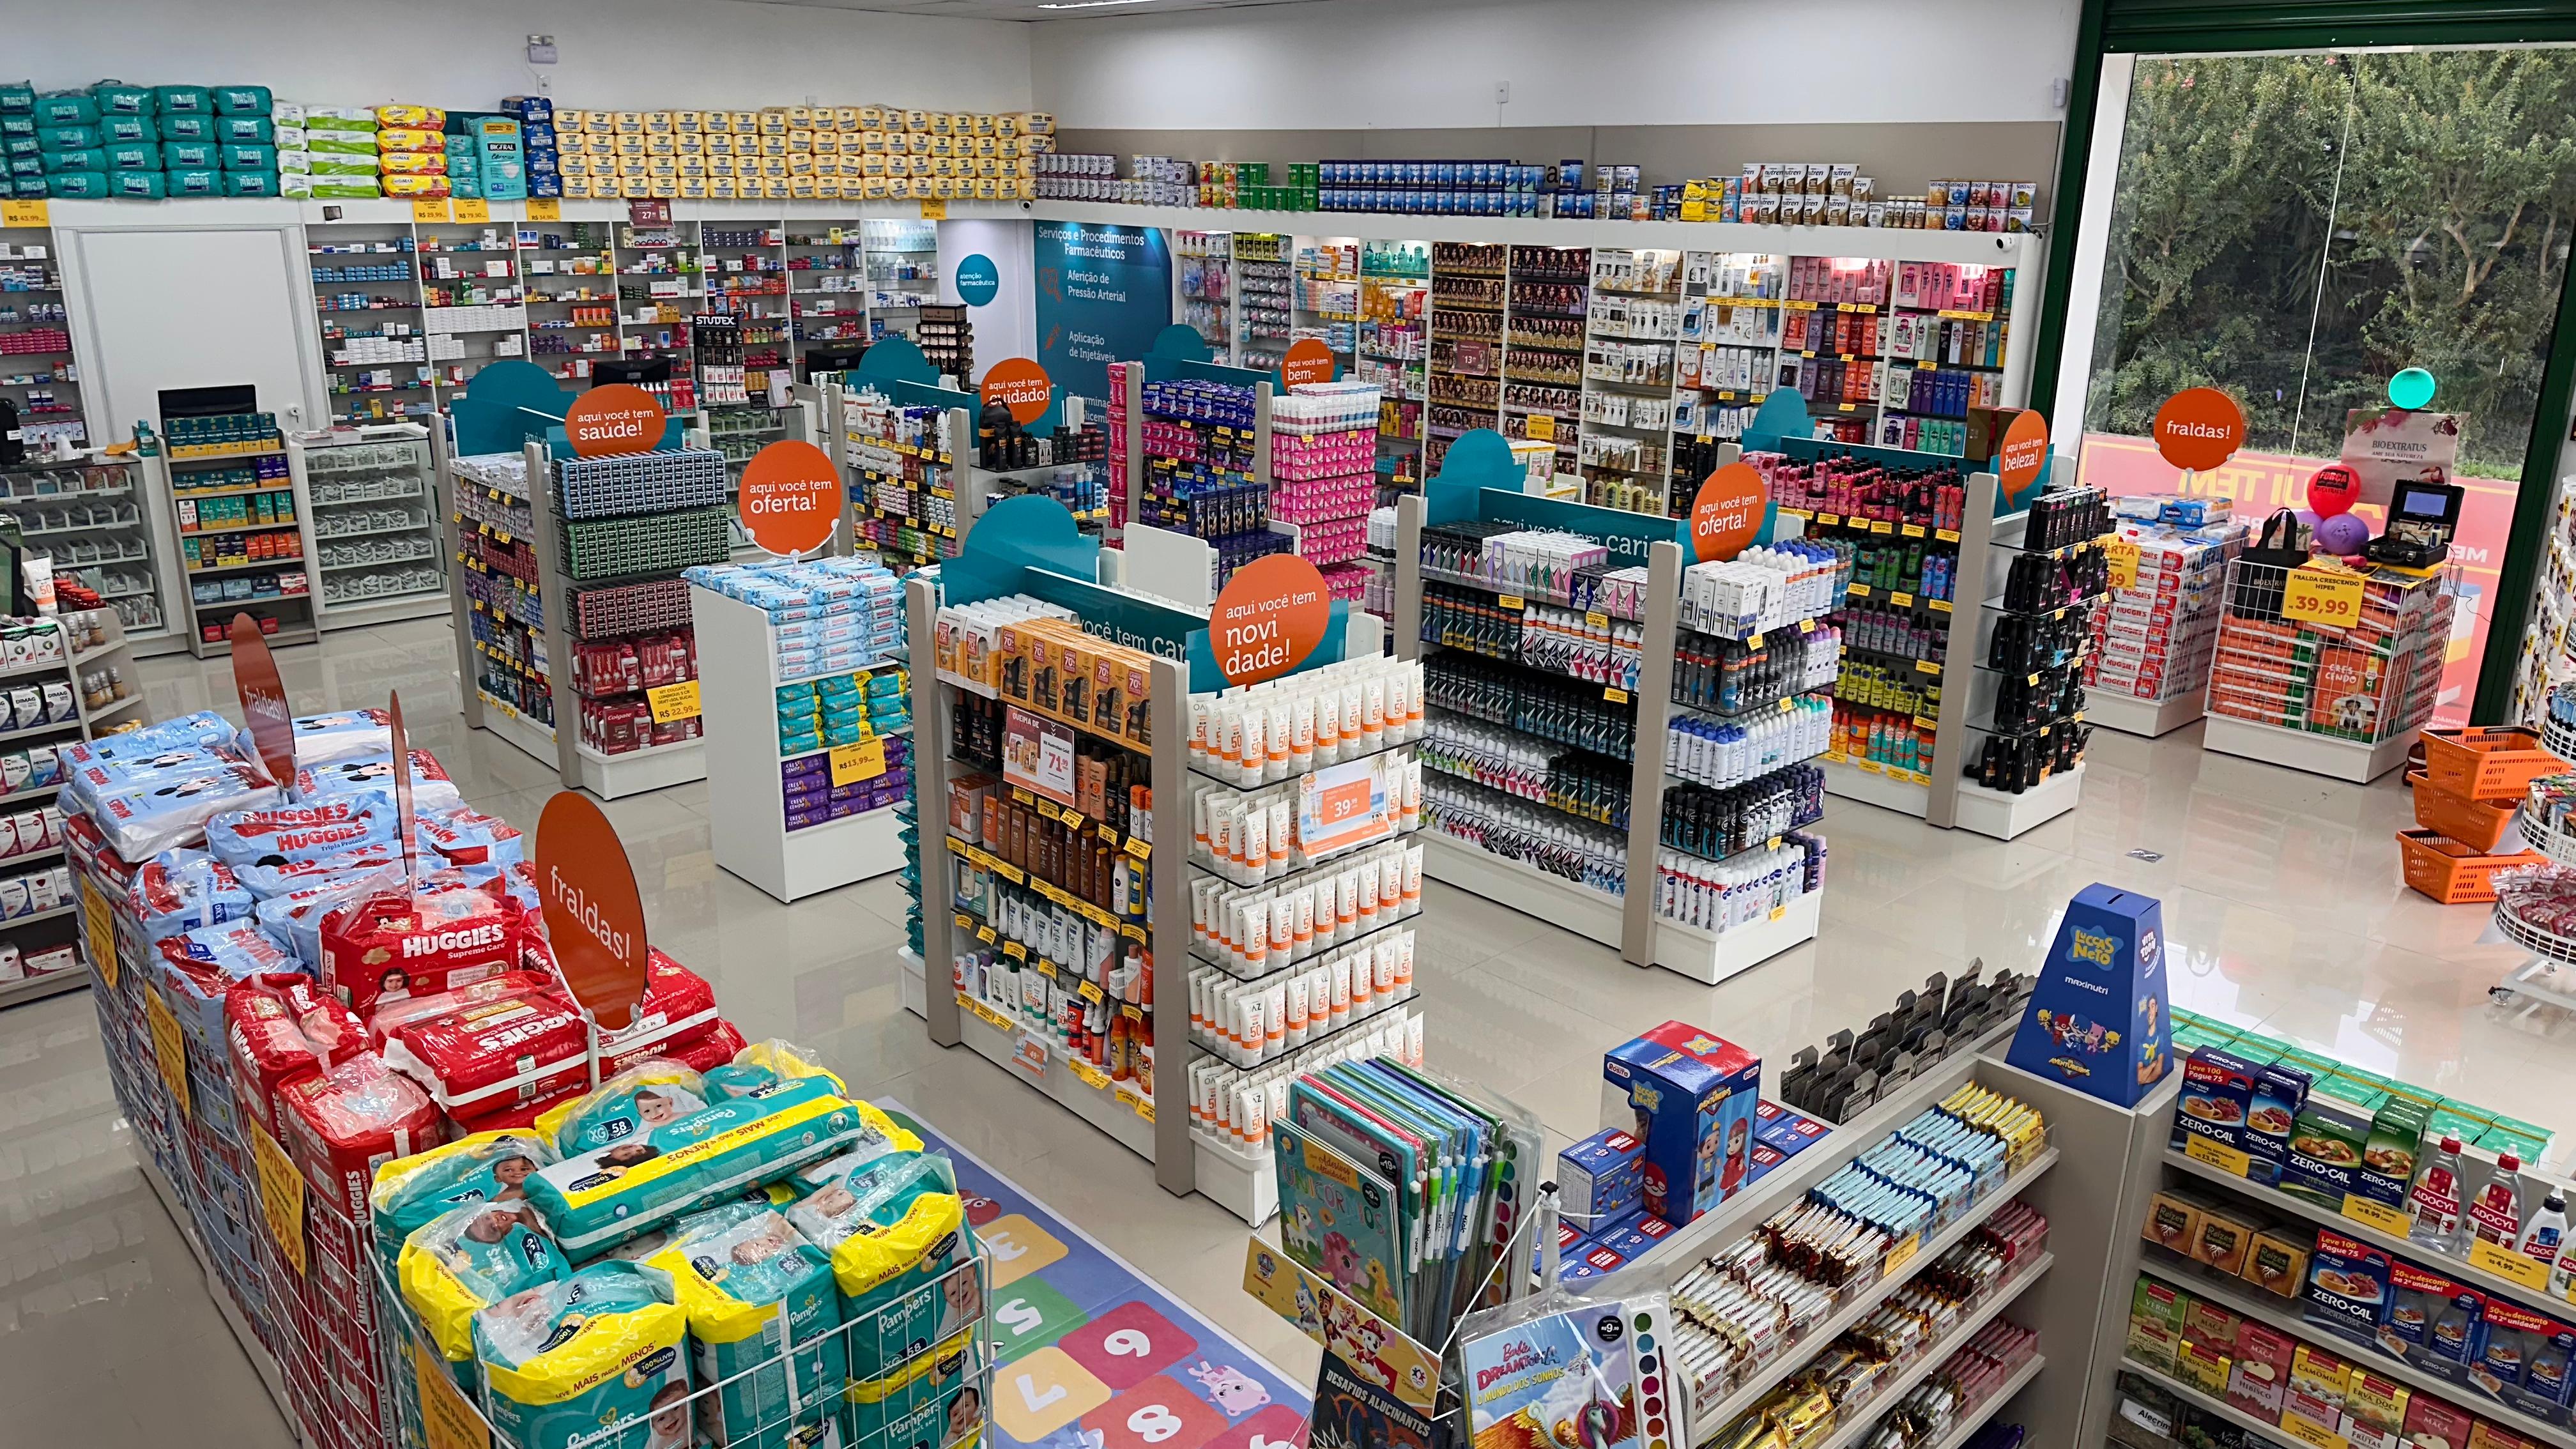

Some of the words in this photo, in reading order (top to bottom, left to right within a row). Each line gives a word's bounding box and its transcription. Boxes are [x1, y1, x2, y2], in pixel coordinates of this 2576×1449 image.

[1038, 226, 1071, 243] Serviços
[1080, 229, 1144, 245] Procedimentos
[1065, 244, 1124, 259] Farmacêuticos
[1068, 270, 1098, 285] Aferição
[1100, 273, 1109, 284] de
[1068, 286, 1096, 298] Pressão
[1098, 289, 1126, 302] Arterial
[696, 316, 735, 325] STUDEX
[1069, 331, 1104, 346] Aplicação
[1070, 347, 1078, 357] de
[1080, 348, 1115, 362] Injetáveis
[1288, 369, 1315, 381] bem-
[988, 381, 1006, 390] aqui
[1008, 379, 1025, 388] você
[990, 387, 1050, 405] cuidado!
[578, 412, 601, 424] aqui
[604, 410, 629, 420] você
[633, 410, 654, 418] tem
[579, 420, 642, 440] saúde!
[2166, 420, 2230, 439] fraldas!
[2006, 442, 2018, 454] aqui
[2019, 439, 2031, 450] você
[2005, 448, 2039, 471] beleza!
[749, 482, 776, 495] aqui
[779, 480, 806, 491] você
[810, 480, 832, 490] tem
[751, 492, 816, 514] oferta!
[1700, 503, 1719, 517] aqui
[1720, 496, 1740, 511] você
[1742, 494, 1757, 506] tem
[1698, 511, 1747, 537] oferta!
[2320, 577, 2359, 586] CRESCENDO
[1227, 602, 1255, 620] aqui
[1258, 594, 1288, 612] você
[1292, 591, 1316, 605] tem
[2296, 595, 2349, 615] 39,99
[1116, 626, 1147, 652] tem
[1226, 613, 1278, 648] novi
[1225, 639, 1290, 676] dade!
[245, 685, 284, 721] fraldas!
[671, 706, 693, 716] 22,99
[1032, 719, 1039, 728] DE
[848, 756, 868, 767] 13,99
[1130, 813, 1138, 825] 70
[276, 822, 367, 852] HUGGIES
[1390, 884, 1399, 896] 50
[551, 864, 630, 967] fraldas!
[1282, 925, 1291, 938] 50
[402, 924, 503, 958] HUGGIES
[1254, 935, 1264, 948] 50
[448, 947, 486, 959] Supreme
[486, 942, 506, 952] Care
[1402, 961, 1411, 973] 50
[2065, 976, 2108, 995] maxinutri
[1298, 1006, 1307, 1018] 50
[1250, 1025, 1261, 1038] 50
[2188, 1064, 2205, 1073] Leve
[2188, 1071, 2211, 1081] Pague
[590, 1126, 606, 1140] XG
[612, 1122, 626, 1133] 58
[1319, 1154, 1351, 1176] Adesivos
[346, 1169, 360, 1229] HUGGIES
[1282, 1161, 1385, 1236] UNICÓRNIOS
[2414, 1188, 2457, 1213] ADOCYL
[2472, 1207, 2515, 1231] ADOCYL
[2321, 1236, 2339, 1246] Leve
[2341, 1241, 2356, 1249] 100
[2322, 1243, 2346, 1255] Pague
[878, 1264, 900, 1280] MAIS
[918, 1232, 944, 1258] MENOS
[1747, 1254, 1762, 1268] Ritter
[2496, 1261, 2513, 1271] 4,99
[2412, 1280, 2443, 1292] unidade!
[2416, 1274, 2450, 1287] desconto
[879, 1290, 931, 1333] Pampers
[2146, 1299, 2172, 1316] VERDE
[1754, 1325, 1771, 1342] Ritter
[1503, 1340, 1531, 1363] Barbie
[573, 1374, 599, 1393] MAIS
[601, 1364, 619, 1379] PAGUE
[621, 1342, 654, 1368] MENOS
[1477, 1345, 1560, 1391] DREAMTOPIA
[1705, 1365, 1722, 1382] Ritter
[2297, 1363, 2342, 1387] CAMOMILA
[1477, 1395, 1482, 1406] O
[1485, 1384, 1512, 1403] MUNDO
[1514, 1376, 1530, 1392] DOS
[1532, 1366, 1565, 1385] SONHOS
[2239, 1380, 2271, 1399] HIBISCO
[1326, 1368, 1367, 1402] DESAFIOS
[1368, 1392, 1431, 1438] ALUCINANTES
[1809, 1399, 1825, 1414] Ritter
[2354, 1387, 2373, 1402] ERVA
[2375, 1397, 2399, 1413] DOCE
[890, 1400, 940, 1438] Pampers
[2138, 1409, 2171, 1430] Alecrim
[2291, 1404, 2327, 1423] MORANGO
[1126, 1404, 1182, 1443] 8
[2352, 1430, 2381, 1449] FRUTAS
